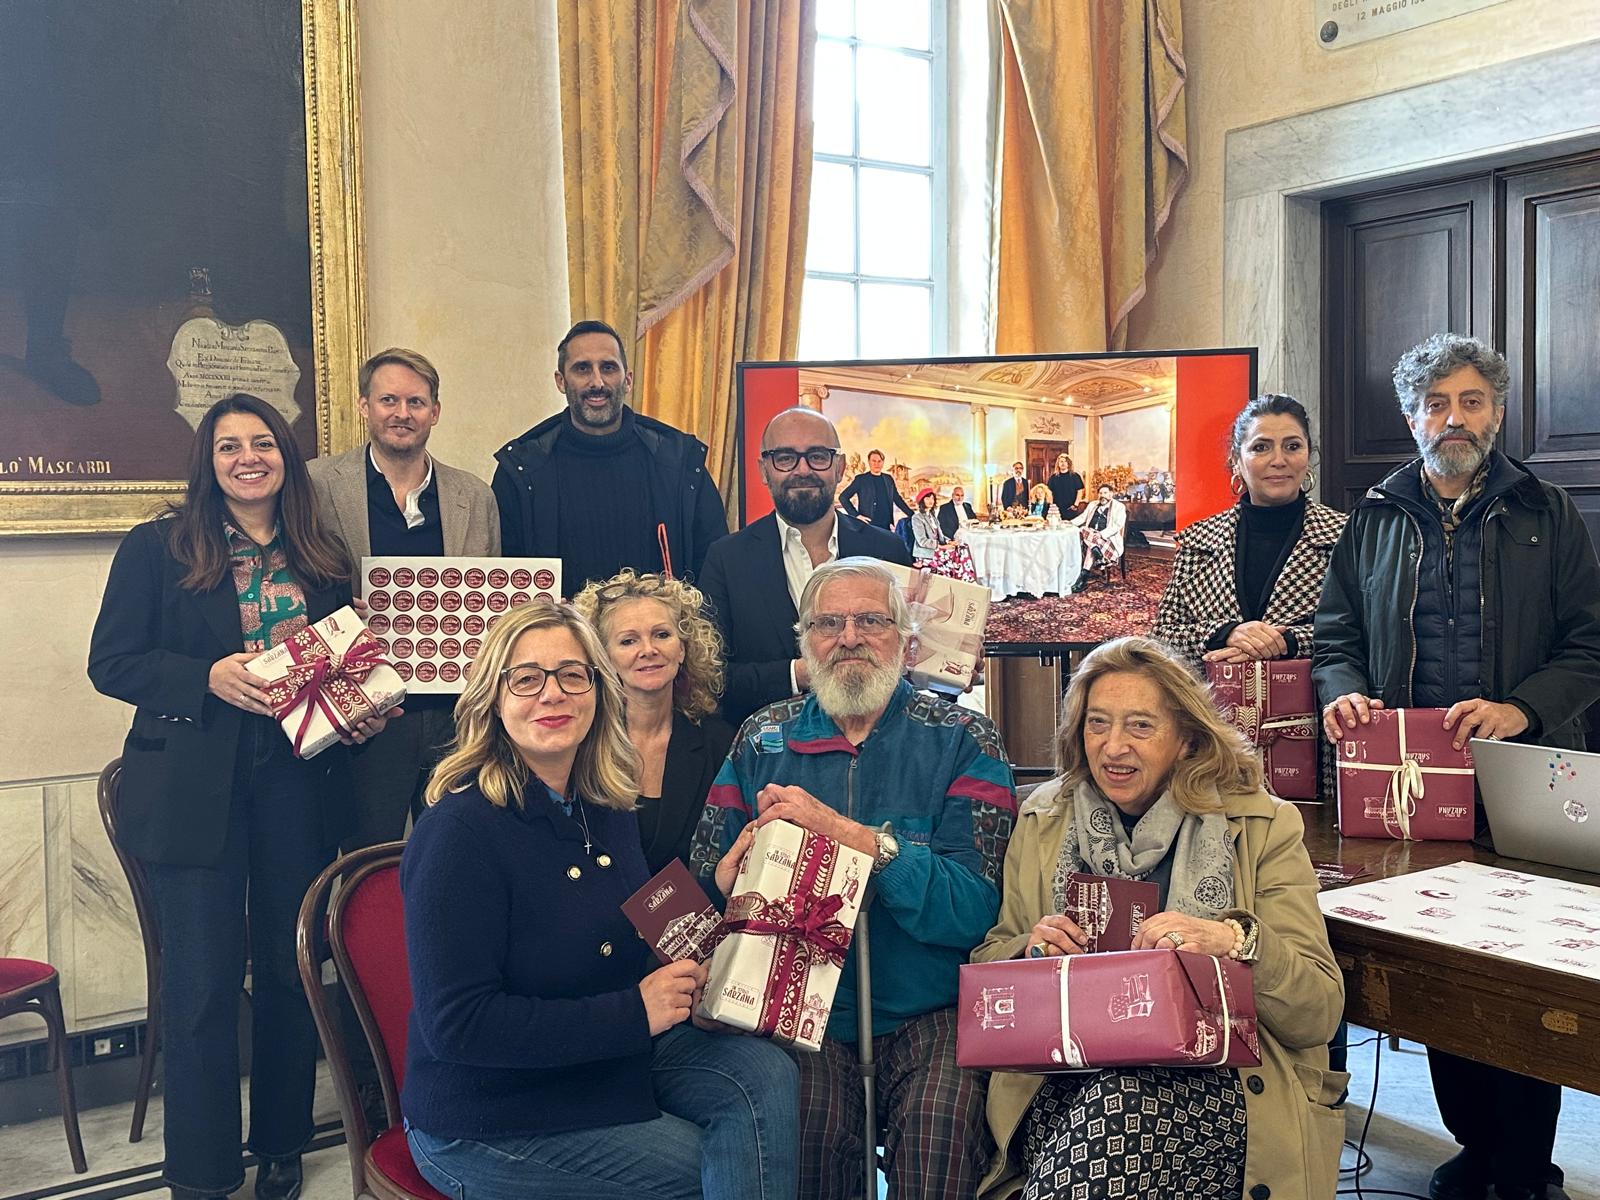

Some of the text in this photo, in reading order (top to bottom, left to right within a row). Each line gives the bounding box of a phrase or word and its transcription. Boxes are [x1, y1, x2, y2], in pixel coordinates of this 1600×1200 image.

[1357, 1, 1407, 21] 12 MAGGIO
[28, 456, 112, 474] MASCARDI
[722, 988, 755, 1006] SARZANA
